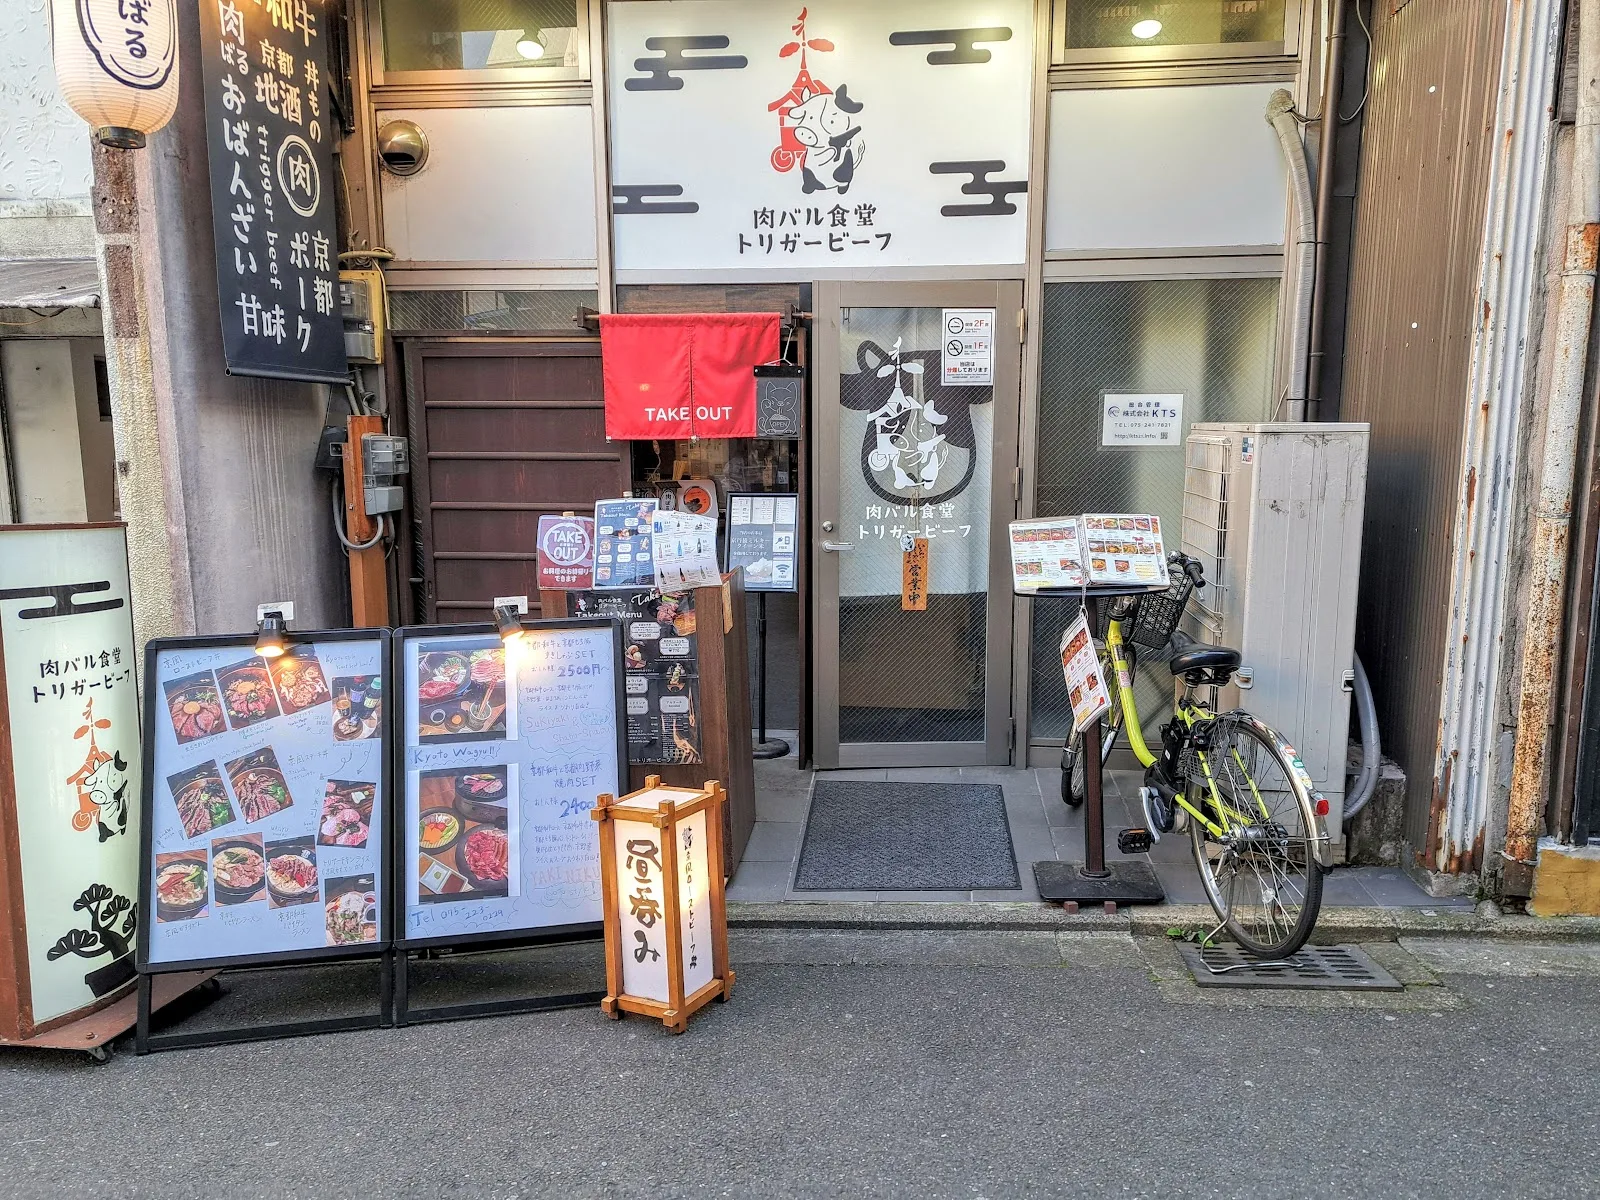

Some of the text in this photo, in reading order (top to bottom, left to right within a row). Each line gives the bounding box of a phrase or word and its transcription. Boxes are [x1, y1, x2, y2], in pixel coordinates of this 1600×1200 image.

[259, 38, 295, 79] 京都
[254, 71, 303, 126] 地酒
[303, 59, 322, 144] 丼もの
[287, 154, 312, 198] 肉
[752, 203, 878, 230] 肉バル食堂
[738, 231, 893, 255] トリガービーフ
[266, 230, 282, 291] beef
[234, 291, 287, 346] 甘味
[645, 405, 733, 422] TAKE OUT
[1122, 409, 1150, 417] 株式会社
[865, 502, 956, 521] 肉バル食堂
[551, 529, 583, 544] TAKE
[858, 523, 973, 540] トリガービーフ
[553, 546, 579, 560] OUT
[616, 610, 642, 618] Menu
[39, 646, 122, 679] 肉バル食堂
[32, 668, 131, 704] トリガービーフ
[414, 749, 449, 764] Kyoto
[411, 908, 435, 926] Tel
